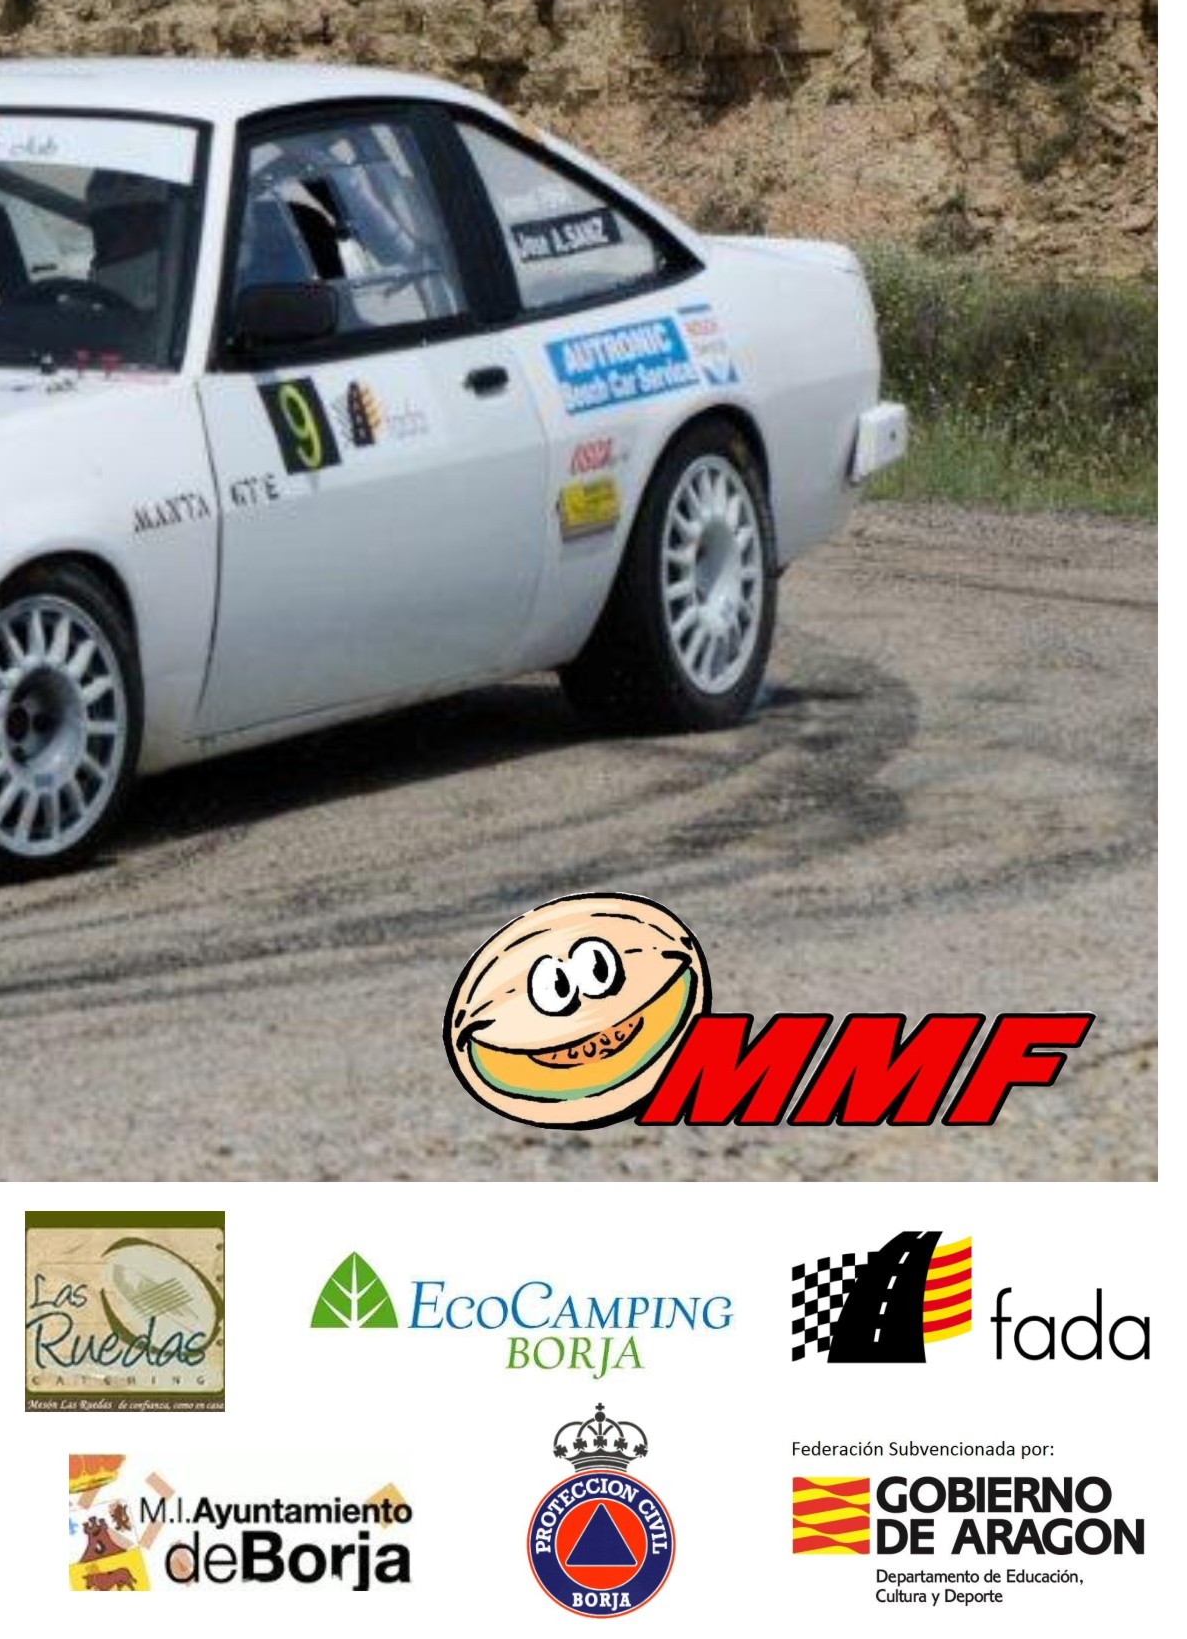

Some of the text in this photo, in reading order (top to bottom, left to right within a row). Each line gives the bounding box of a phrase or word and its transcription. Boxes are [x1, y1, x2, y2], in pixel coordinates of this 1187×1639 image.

[562, 323, 673, 375] AUTRONIC
[278, 383, 322, 468] 9
[634, 1012, 1095, 1126] MMF
[30, 1273, 88, 1309] Las
[25, 1311, 207, 1368] Ruedas
[991, 1286, 1149, 1360] fada
[506, 1336, 644, 1379] BORJA
[792, 1440, 1054, 1459] Federación Subvencionada por:
[876, 1476, 1112, 1513] GOBIERNO
[536, 1478, 668, 1555] PROTECCION CIVIL
[876, 1518, 1145, 1556] DE ARAGON
[875, 1588, 1003, 1607] Cultura y Deporte
[876, 1568, 1084, 1587] Departamento de Educación,
[572, 1592, 631, 1611] BORJA
